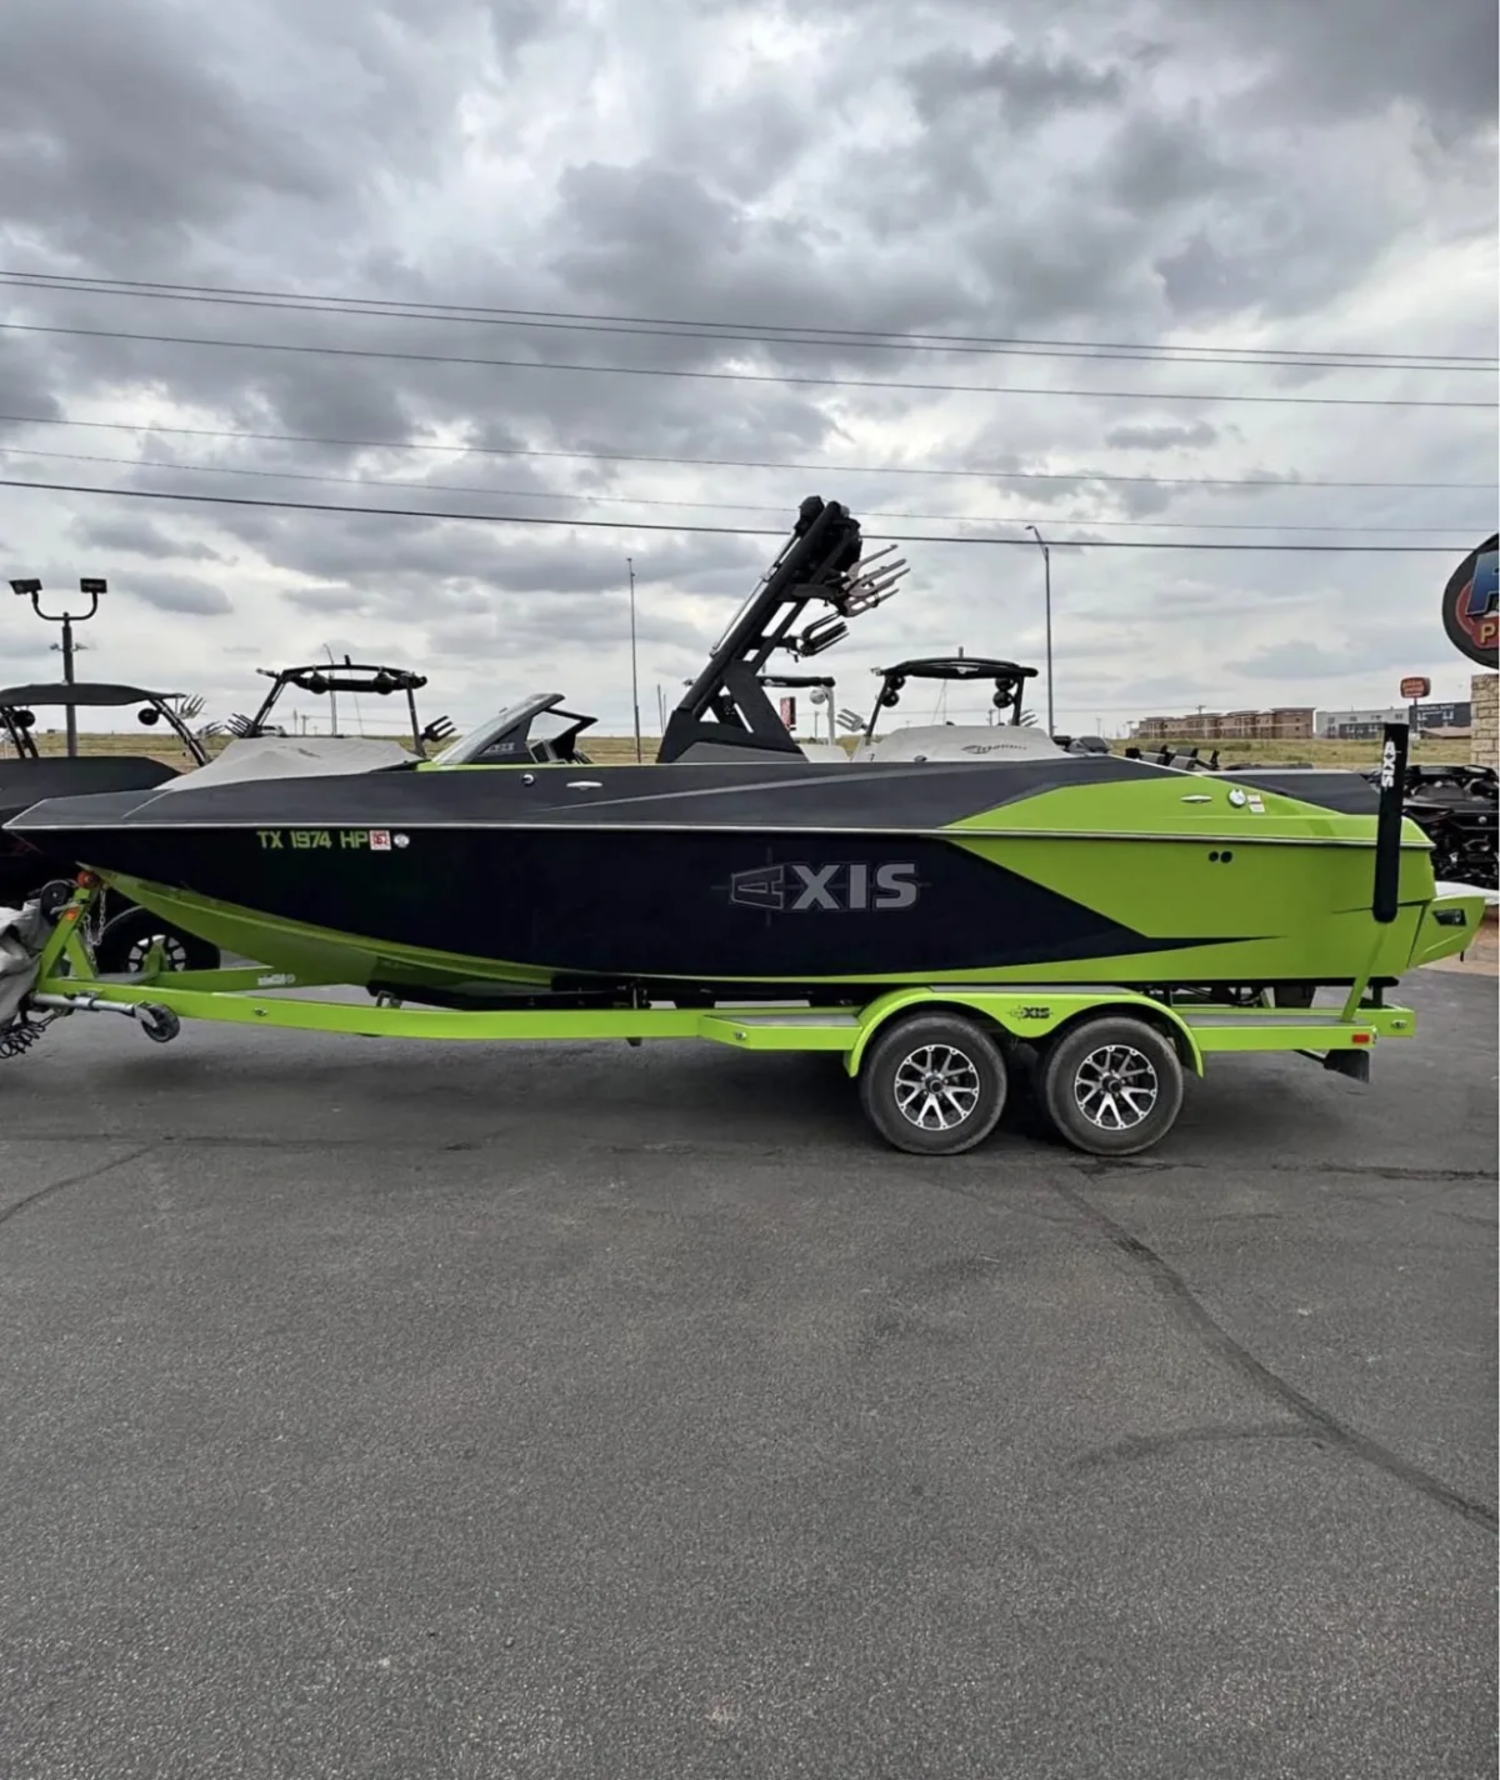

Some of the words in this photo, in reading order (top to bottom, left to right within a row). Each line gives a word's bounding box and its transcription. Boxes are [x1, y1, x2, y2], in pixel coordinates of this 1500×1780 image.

[1381, 741, 1396, 788] AXIS
[257, 831, 283, 848] TX
[290, 831, 332, 848] 1974
[340, 831, 368, 848] HP
